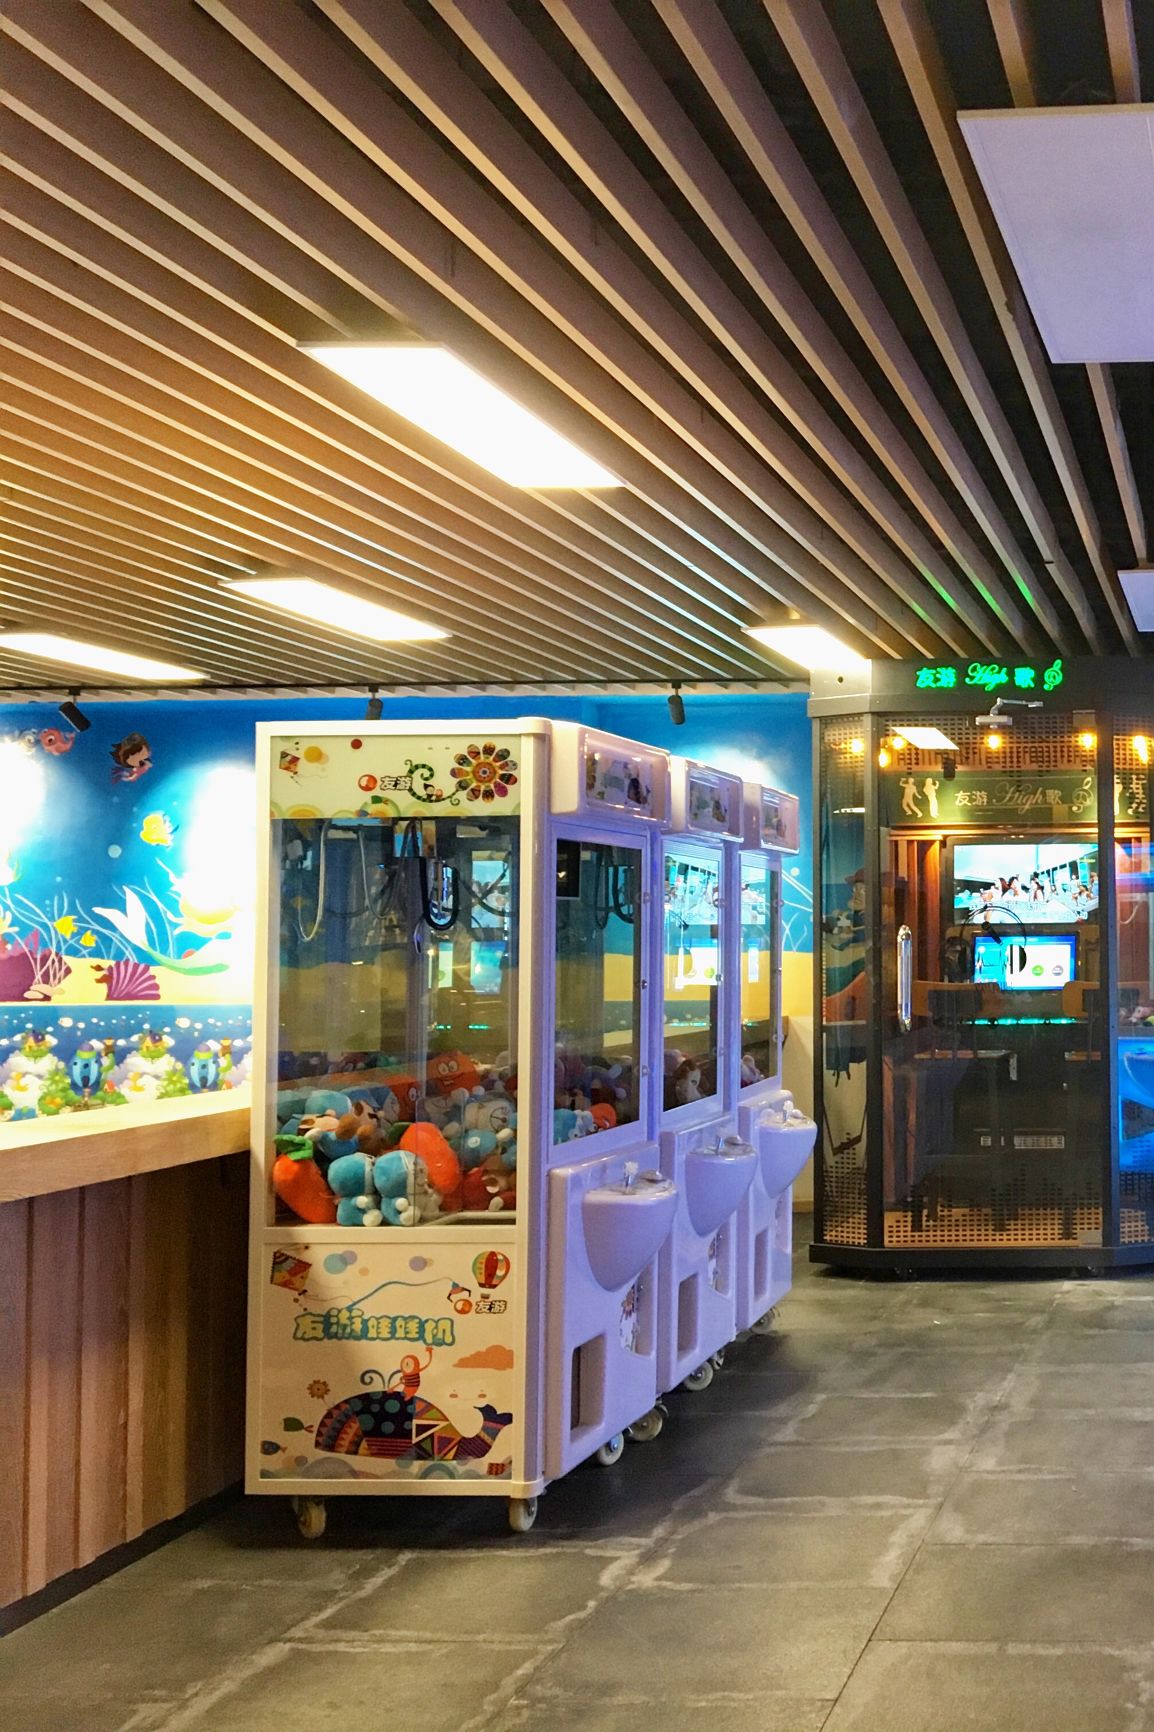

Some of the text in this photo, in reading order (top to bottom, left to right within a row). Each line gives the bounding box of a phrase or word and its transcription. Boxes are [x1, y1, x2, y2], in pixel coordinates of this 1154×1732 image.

[916, 662, 1035, 692] 友游 High 歌
[379, 775, 412, 791] 友游
[954, 781, 1063, 814] 友游 High 歌
[474, 1299, 508, 1315] 友游
[293, 1307, 456, 1347] 友游娃娃机
